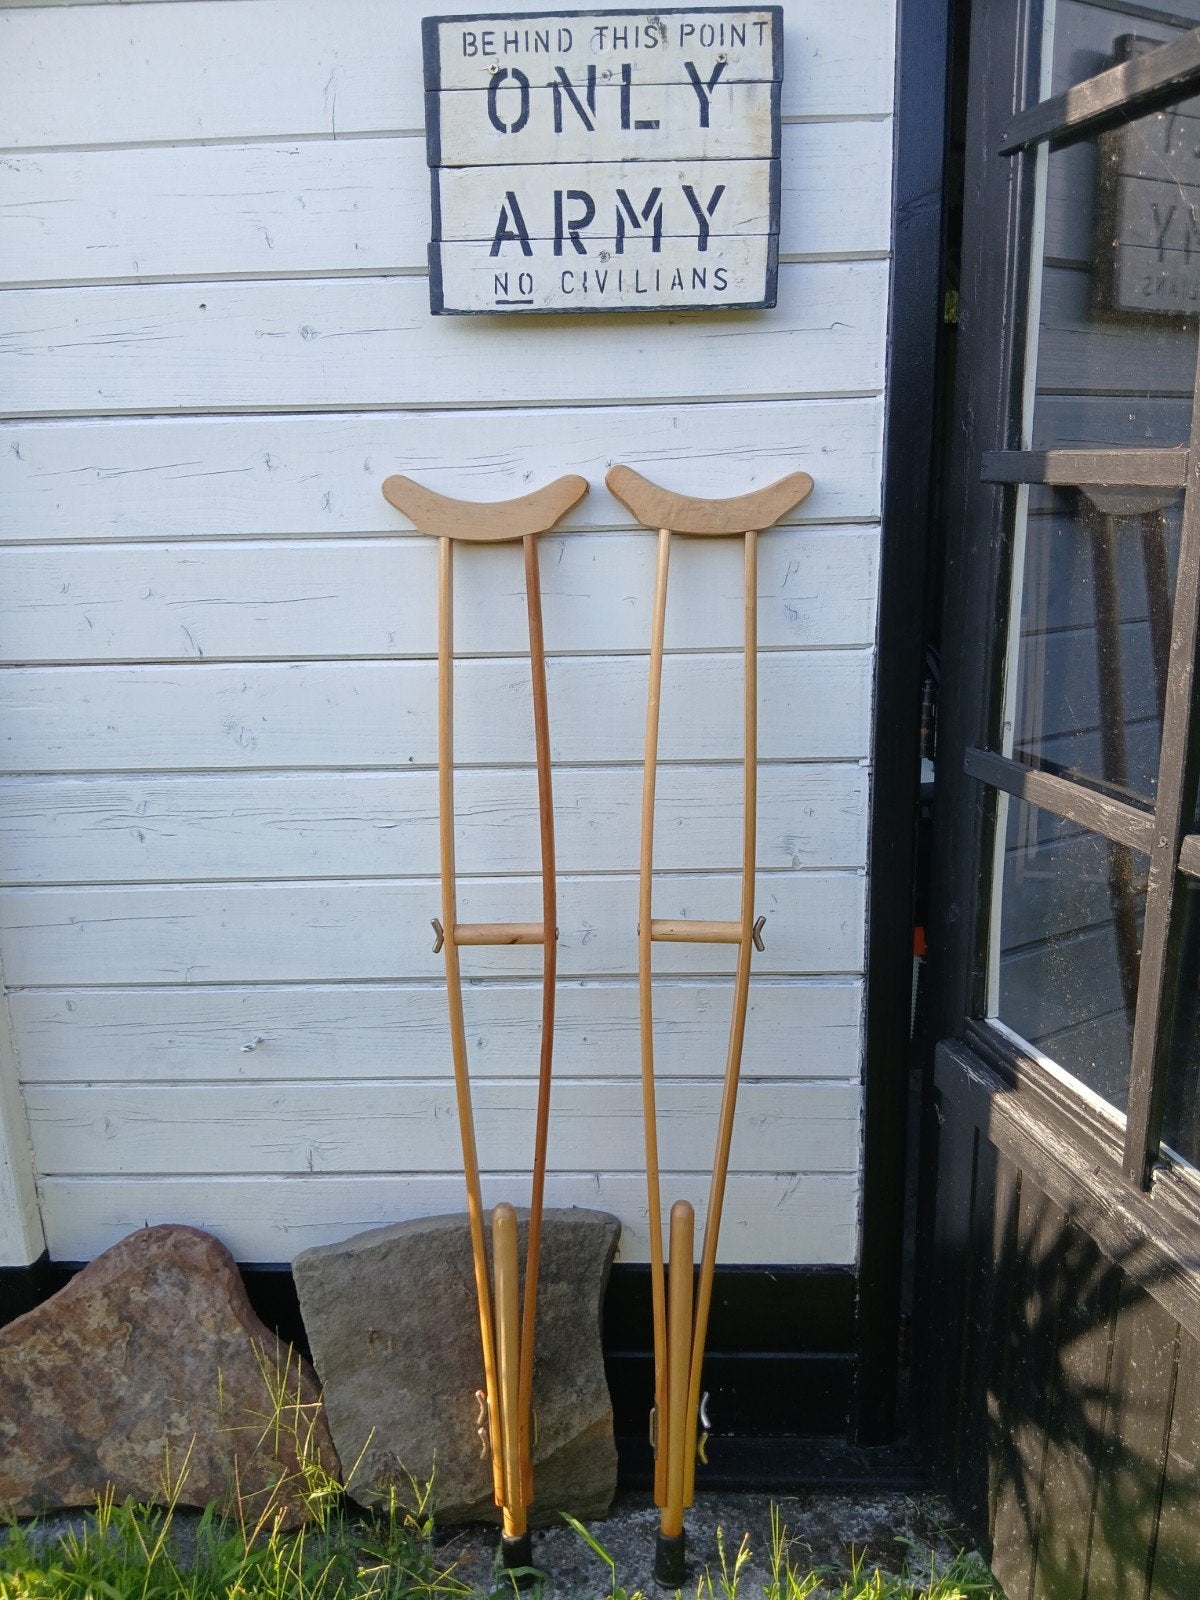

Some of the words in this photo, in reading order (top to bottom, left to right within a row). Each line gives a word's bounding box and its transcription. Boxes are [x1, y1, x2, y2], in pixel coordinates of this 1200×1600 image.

[462, 28, 573, 57] BEHIND
[594, 26, 659, 49] THIS
[679, 21, 768, 48] POINT
[487, 61, 727, 134] ONLY
[489, 184, 726, 257] ARMY
[494, 272, 534, 296] NO
[561, 267, 728, 294] CIVILIANS
